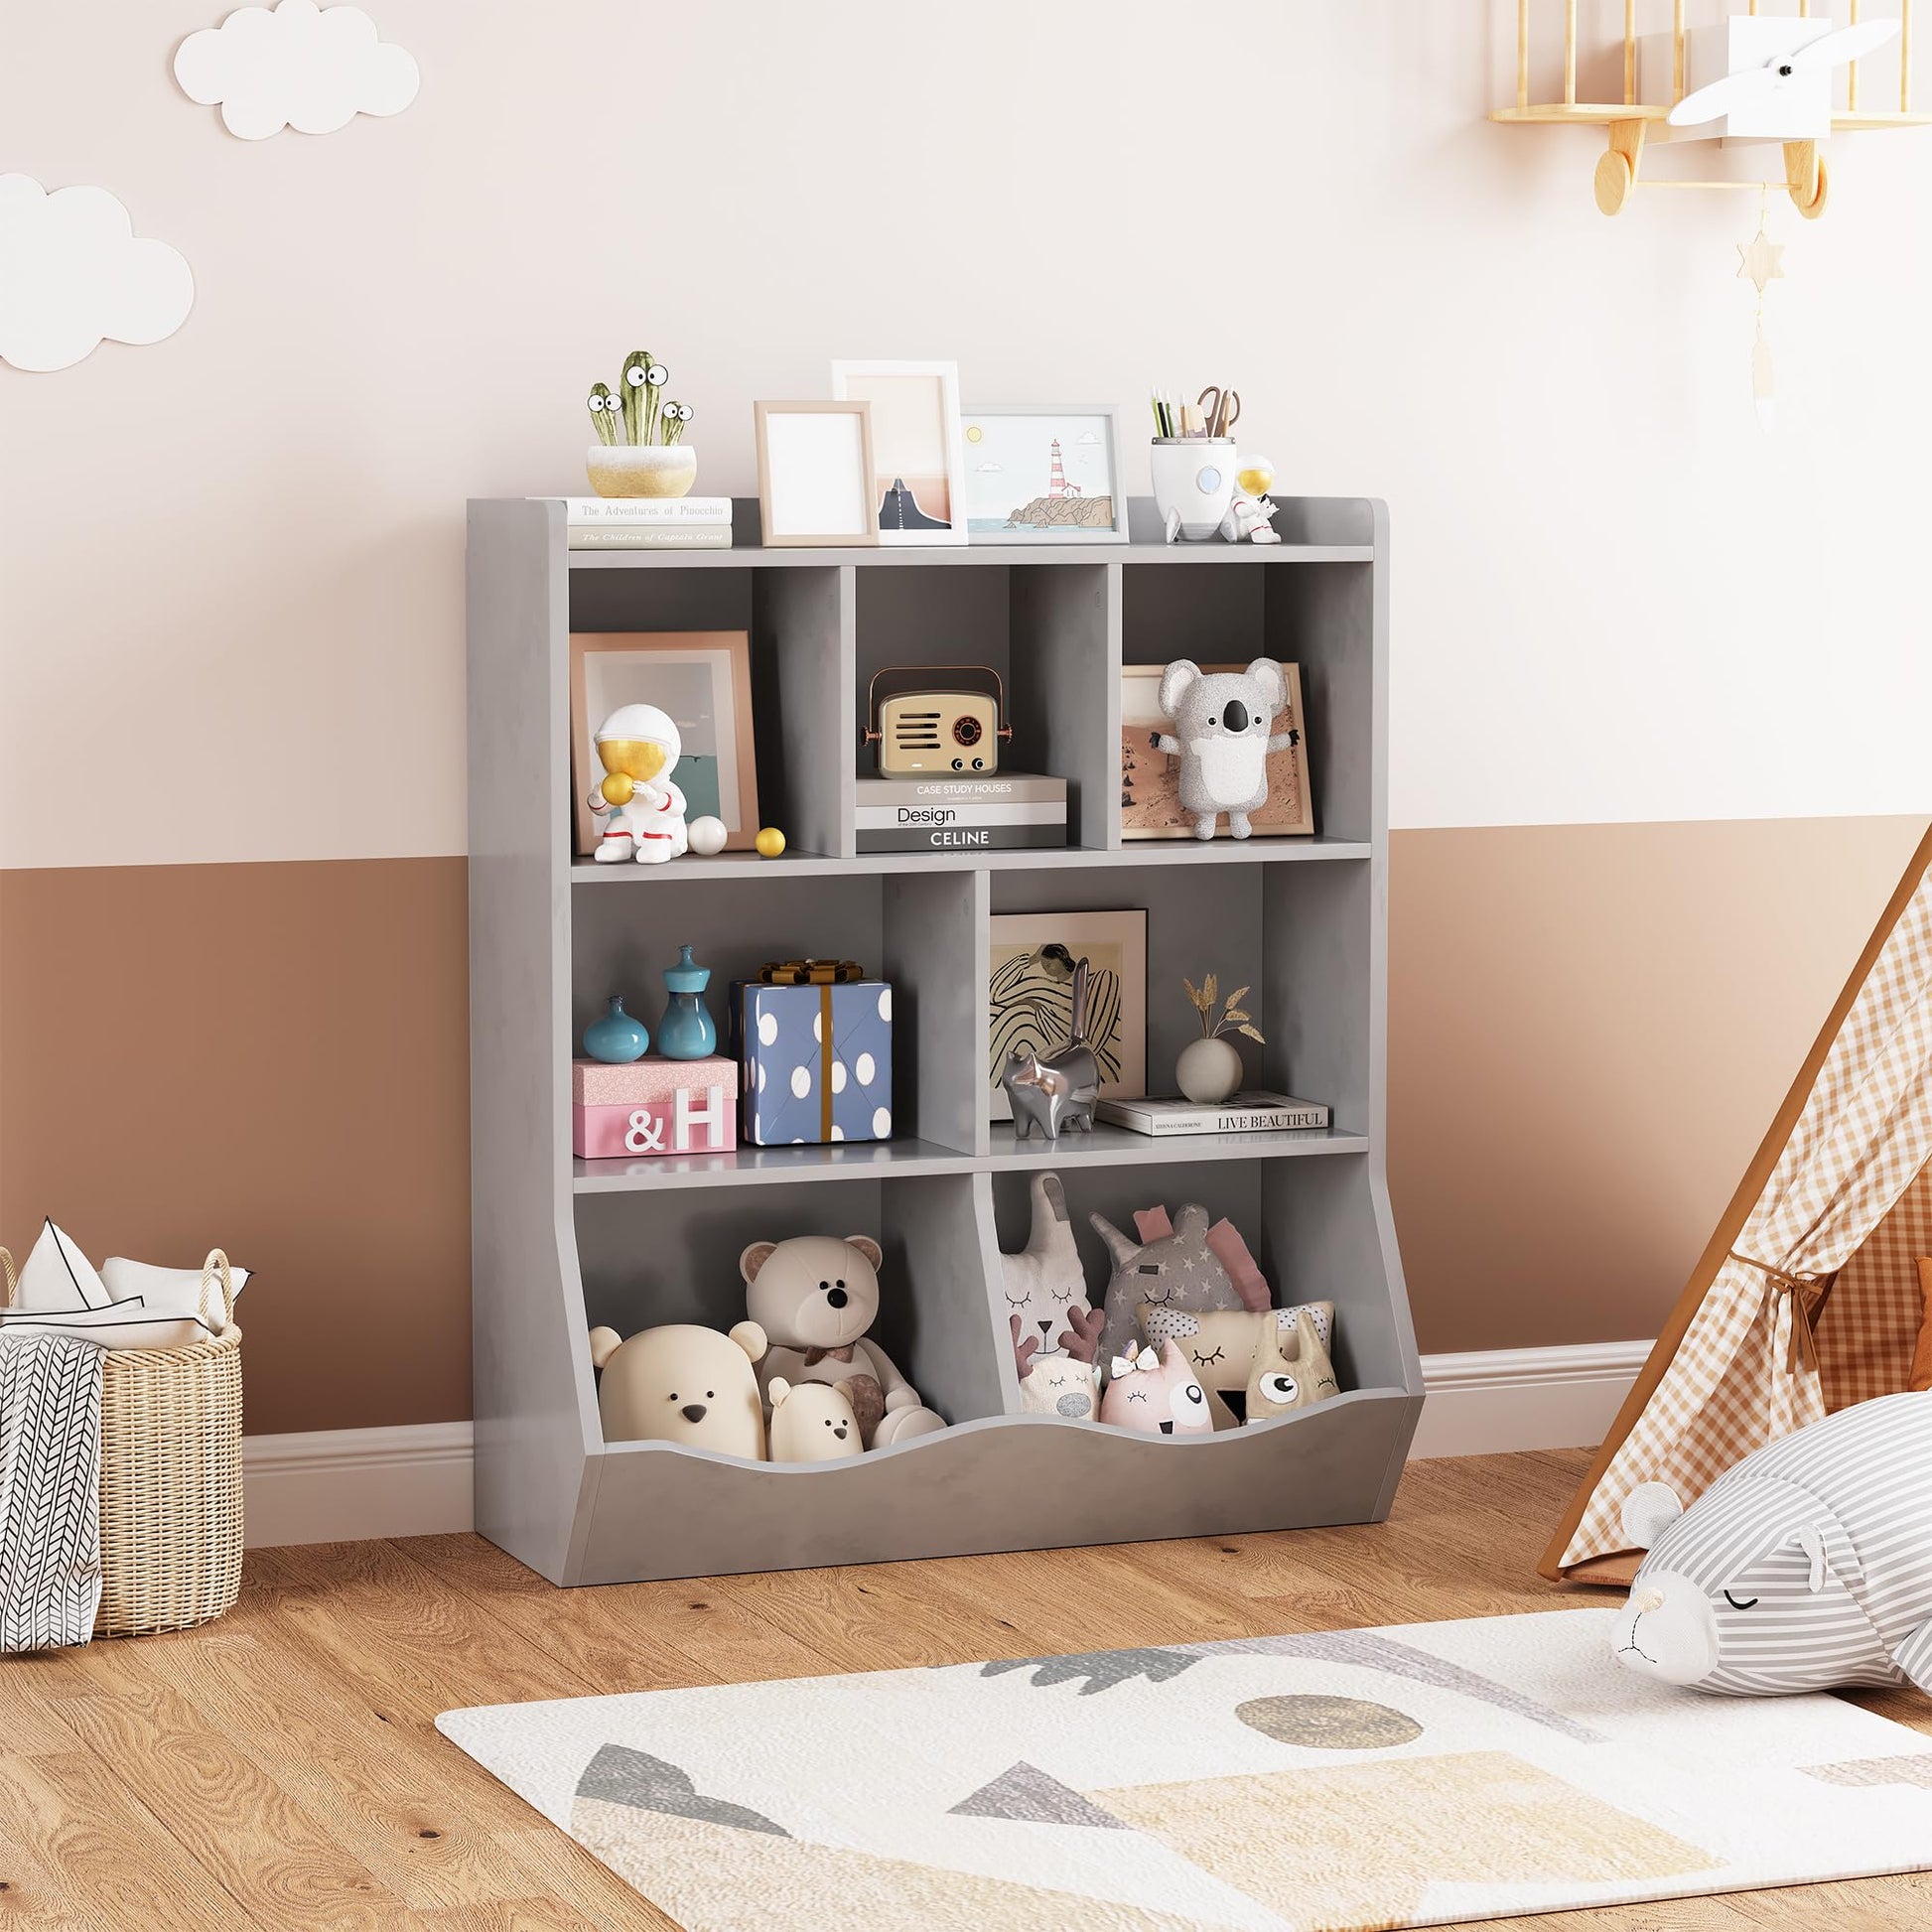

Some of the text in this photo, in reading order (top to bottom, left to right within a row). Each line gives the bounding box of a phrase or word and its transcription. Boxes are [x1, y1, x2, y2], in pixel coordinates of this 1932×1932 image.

[582, 505, 724, 516] The Adventures of Pinocchio
[582, 533, 723, 543] The Children of Captain Grant
[917, 783, 1012, 795] CASE STUDY HOUSES
[897, 807, 956, 826] Design
[930, 831, 990, 846] CELINE
[624, 1085, 724, 1153] & H
[1218, 1113, 1323, 1130] LIVE BEAUTIFUL
